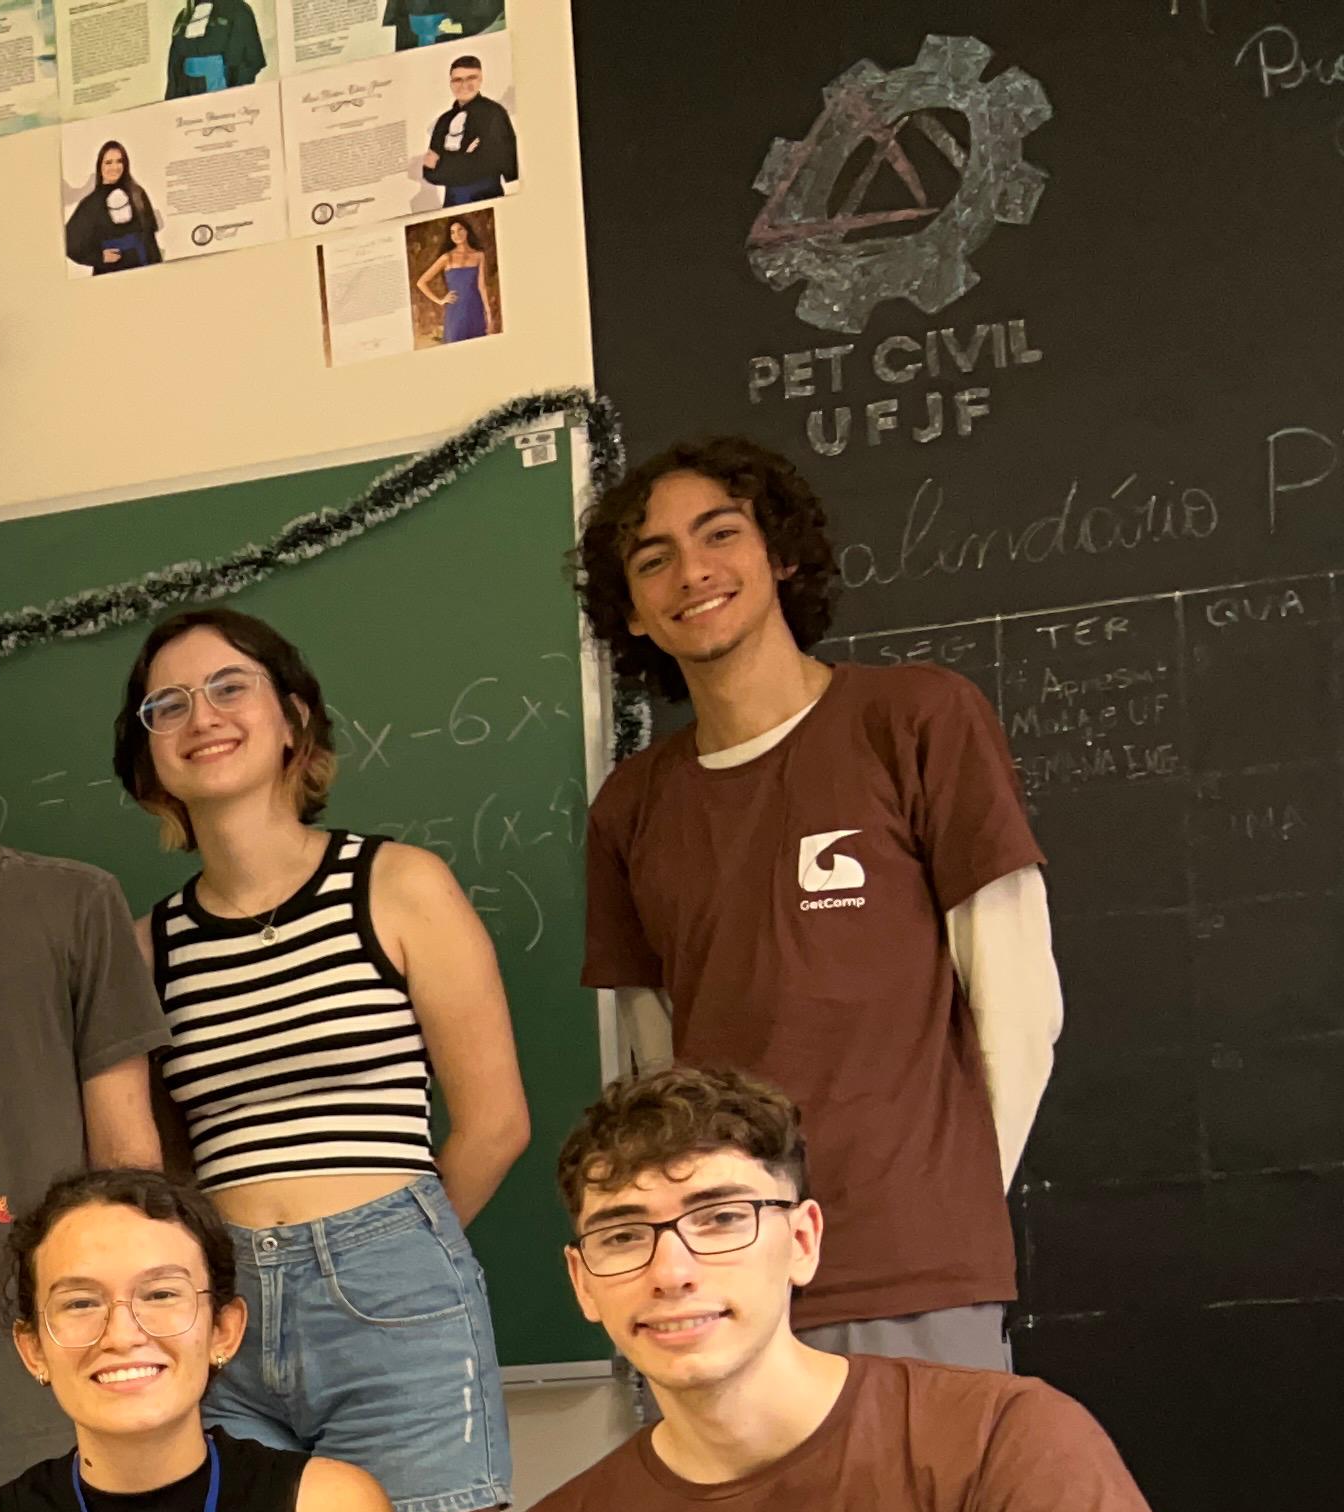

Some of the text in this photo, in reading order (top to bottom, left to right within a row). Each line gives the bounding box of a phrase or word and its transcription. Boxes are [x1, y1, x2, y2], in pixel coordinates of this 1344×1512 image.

[748, 319, 1043, 404] PET CIVIL
[1265, 427, 1344, 535] P
[878, 589, 1305, 667] SEG TER QUA
[799, 896, 866, 912] GetComp
